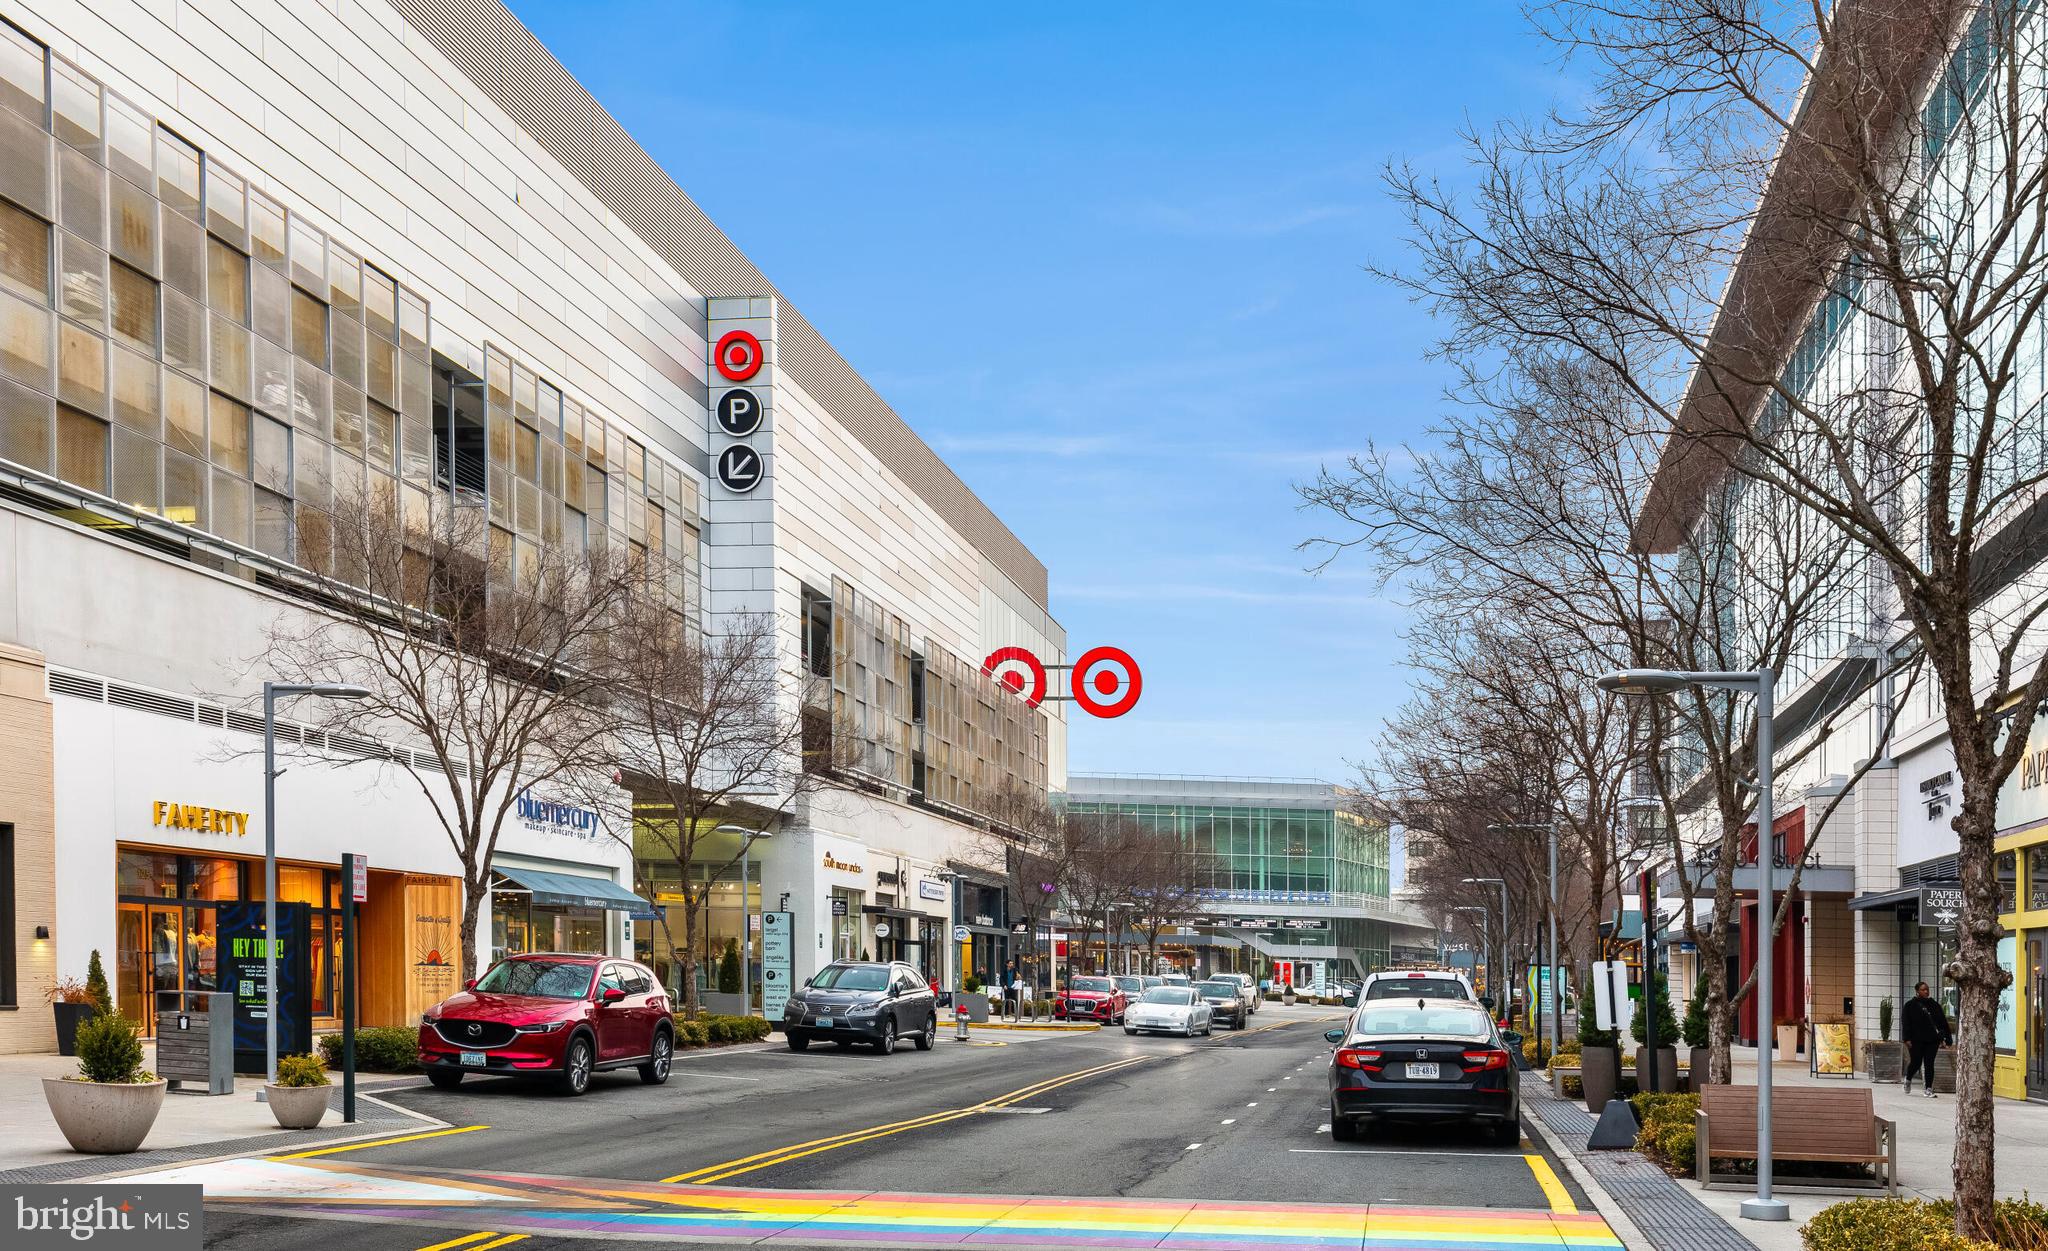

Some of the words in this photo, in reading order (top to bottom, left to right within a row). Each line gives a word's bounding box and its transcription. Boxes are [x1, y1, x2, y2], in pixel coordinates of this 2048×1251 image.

[731, 399, 750, 425] P
[153, 801, 249, 837] FAHERTY
[518, 788, 599, 837] bluemercury
[525, 822, 546, 833] makeup
[550, 827, 573, 837] skincare
[577, 832, 587, 840] spa
[406, 875, 449, 885] FAHERTY
[1930, 890, 1962, 900] PAPER
[233, 938, 250, 958] HEY
